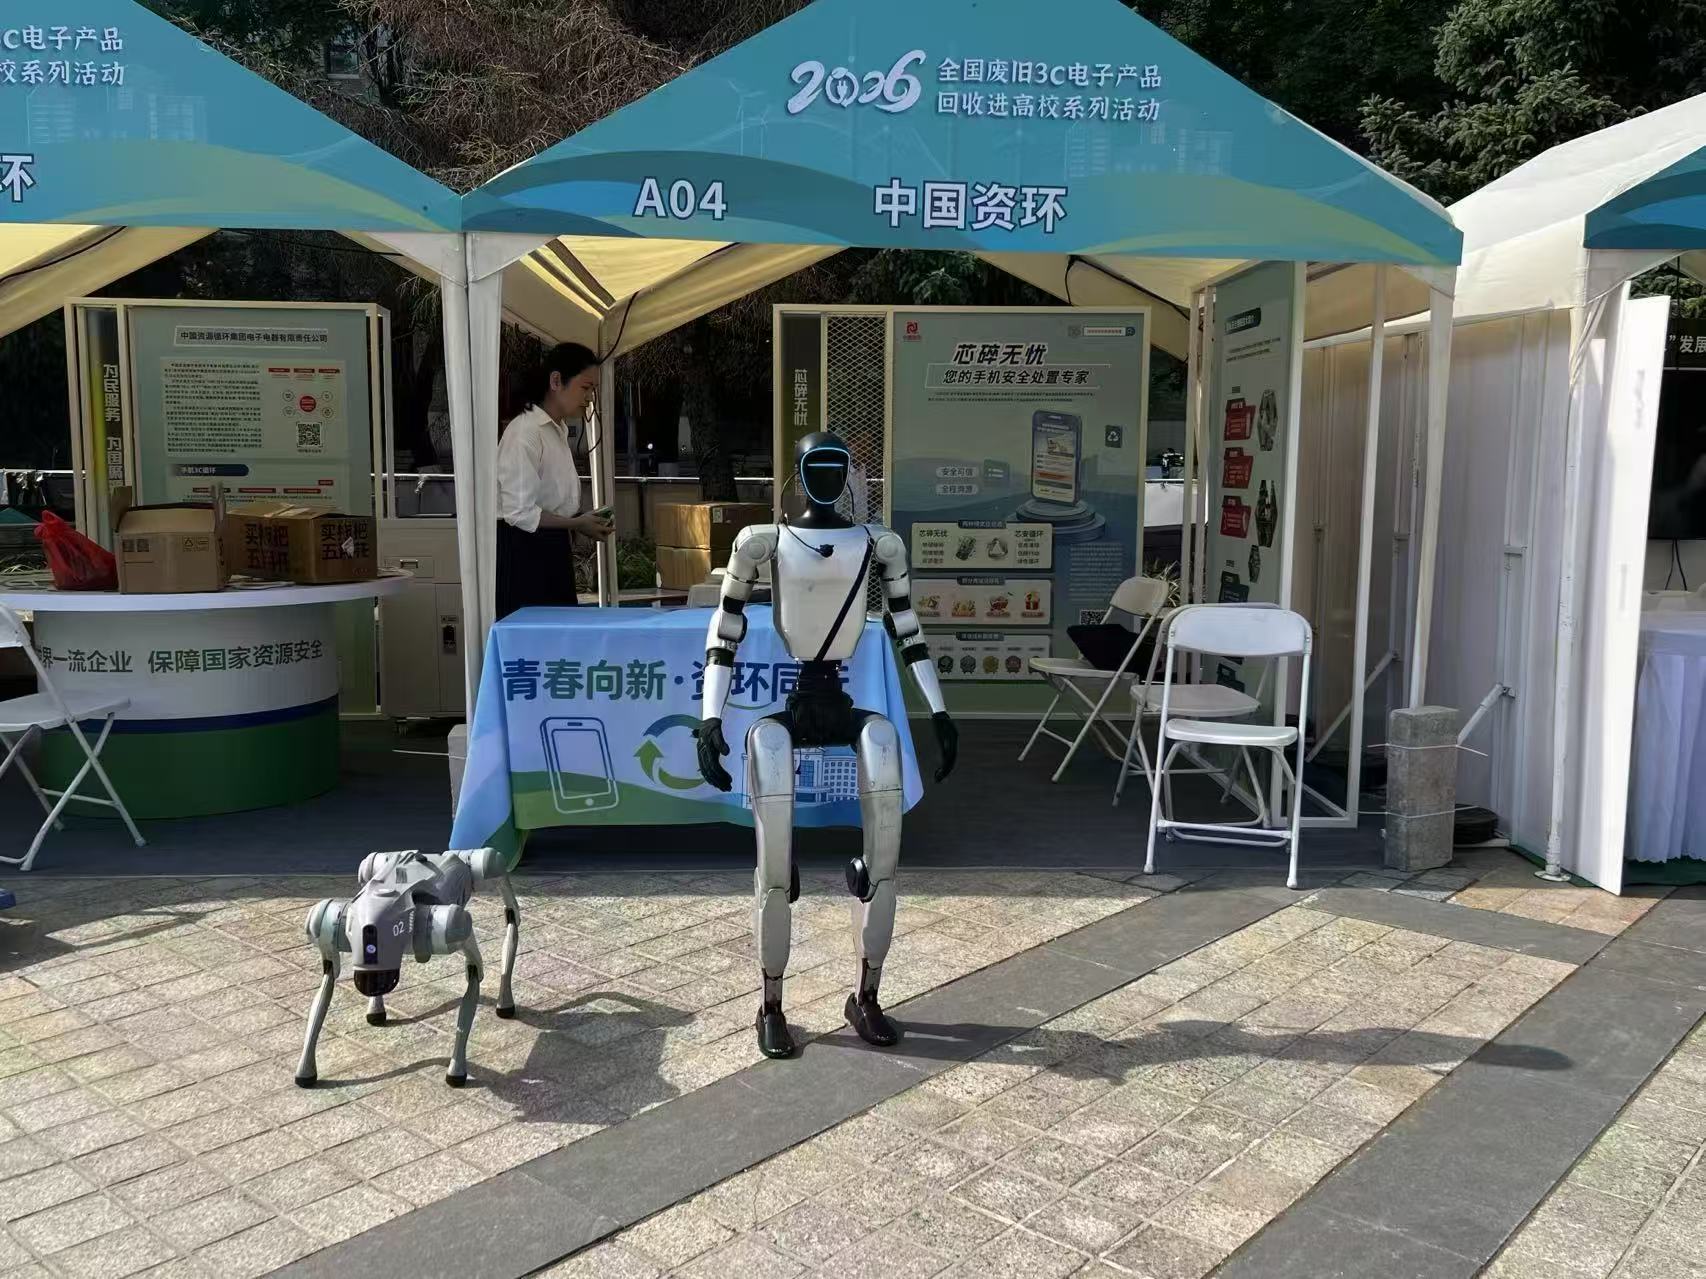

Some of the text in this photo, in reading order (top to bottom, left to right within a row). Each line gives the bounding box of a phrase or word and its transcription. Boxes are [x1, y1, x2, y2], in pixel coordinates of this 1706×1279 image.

[0, 26, 123, 51] C电子产品
[787, 50, 927, 115] 2026
[937, 57, 1162, 89] 全国废旧3C电子产品
[937, 92, 1161, 122] 回收进高校系列活动
[633, 178, 728, 221] A04
[873, 178, 1068, 233] 中国资环
[952, 343, 1048, 365] 芯碎无忧
[943, 370, 1090, 385] 您的手机安全处置专家
[794, 369, 808, 426] 芯碎无忧
[37, 640, 323, 674] 界一流企业 保障国家资源安全
[502, 658, 849, 702] 青春向新·环同
[393, 921, 405, 936] 02
